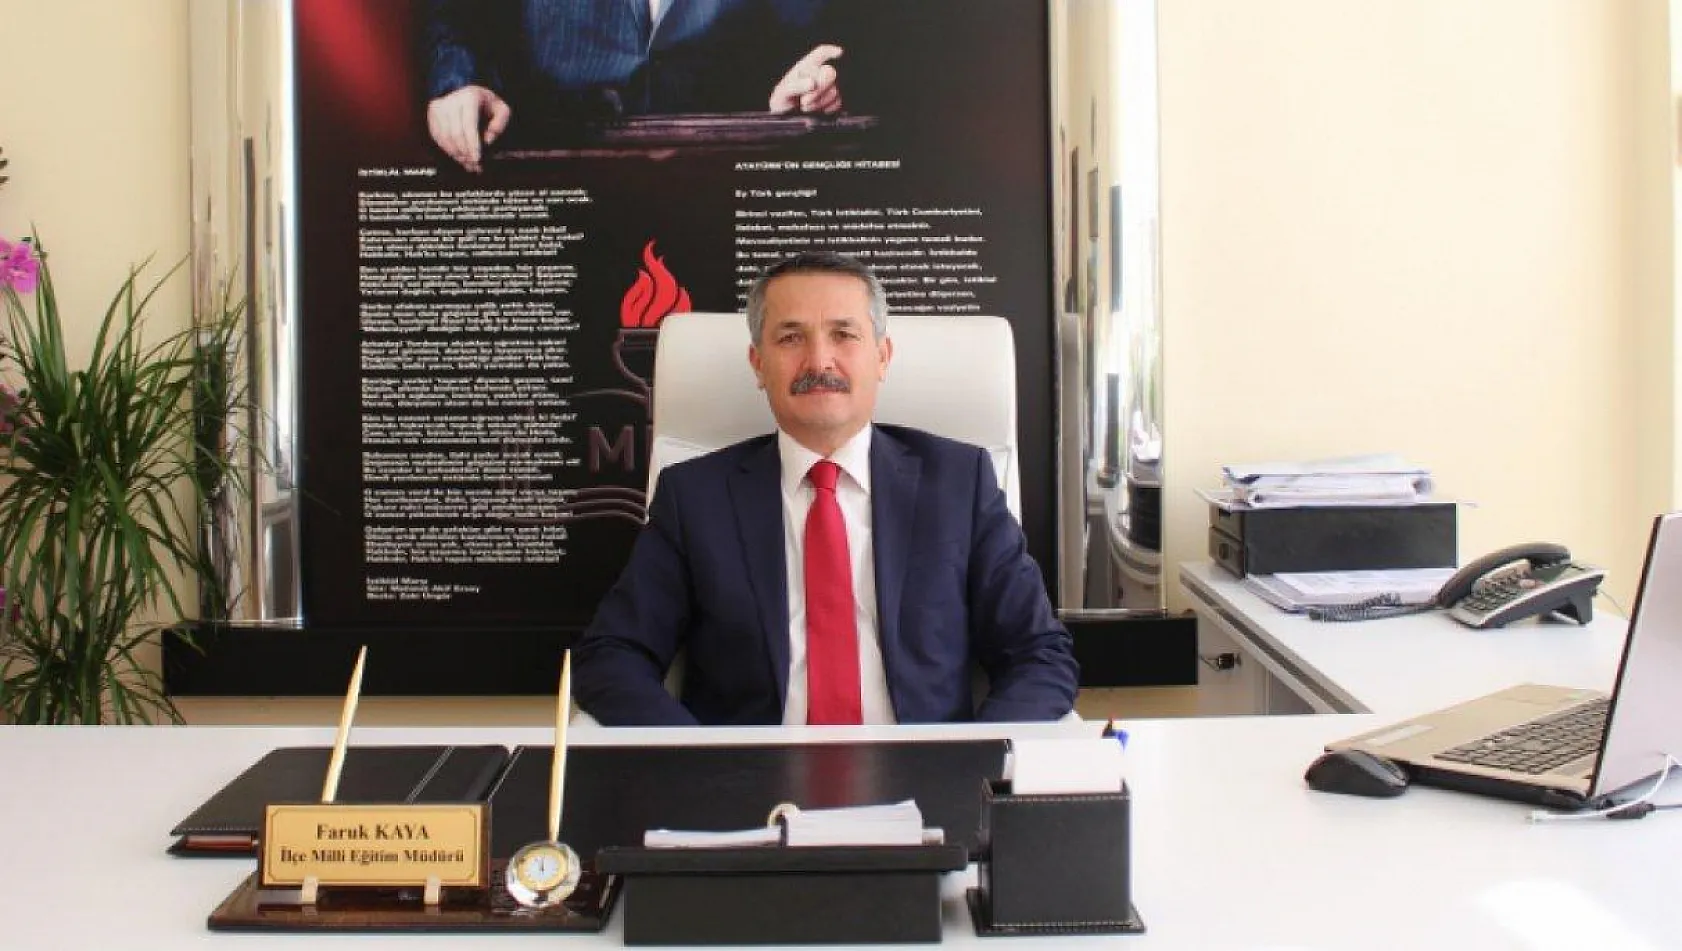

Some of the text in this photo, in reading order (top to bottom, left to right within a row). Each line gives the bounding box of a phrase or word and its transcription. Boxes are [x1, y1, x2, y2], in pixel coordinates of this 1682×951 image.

[749, 189, 772, 197] Türk
[316, 824, 430, 840] Faruk KAYA
[280, 846, 465, 866] İlçe Milli Eğitim Müdürü
